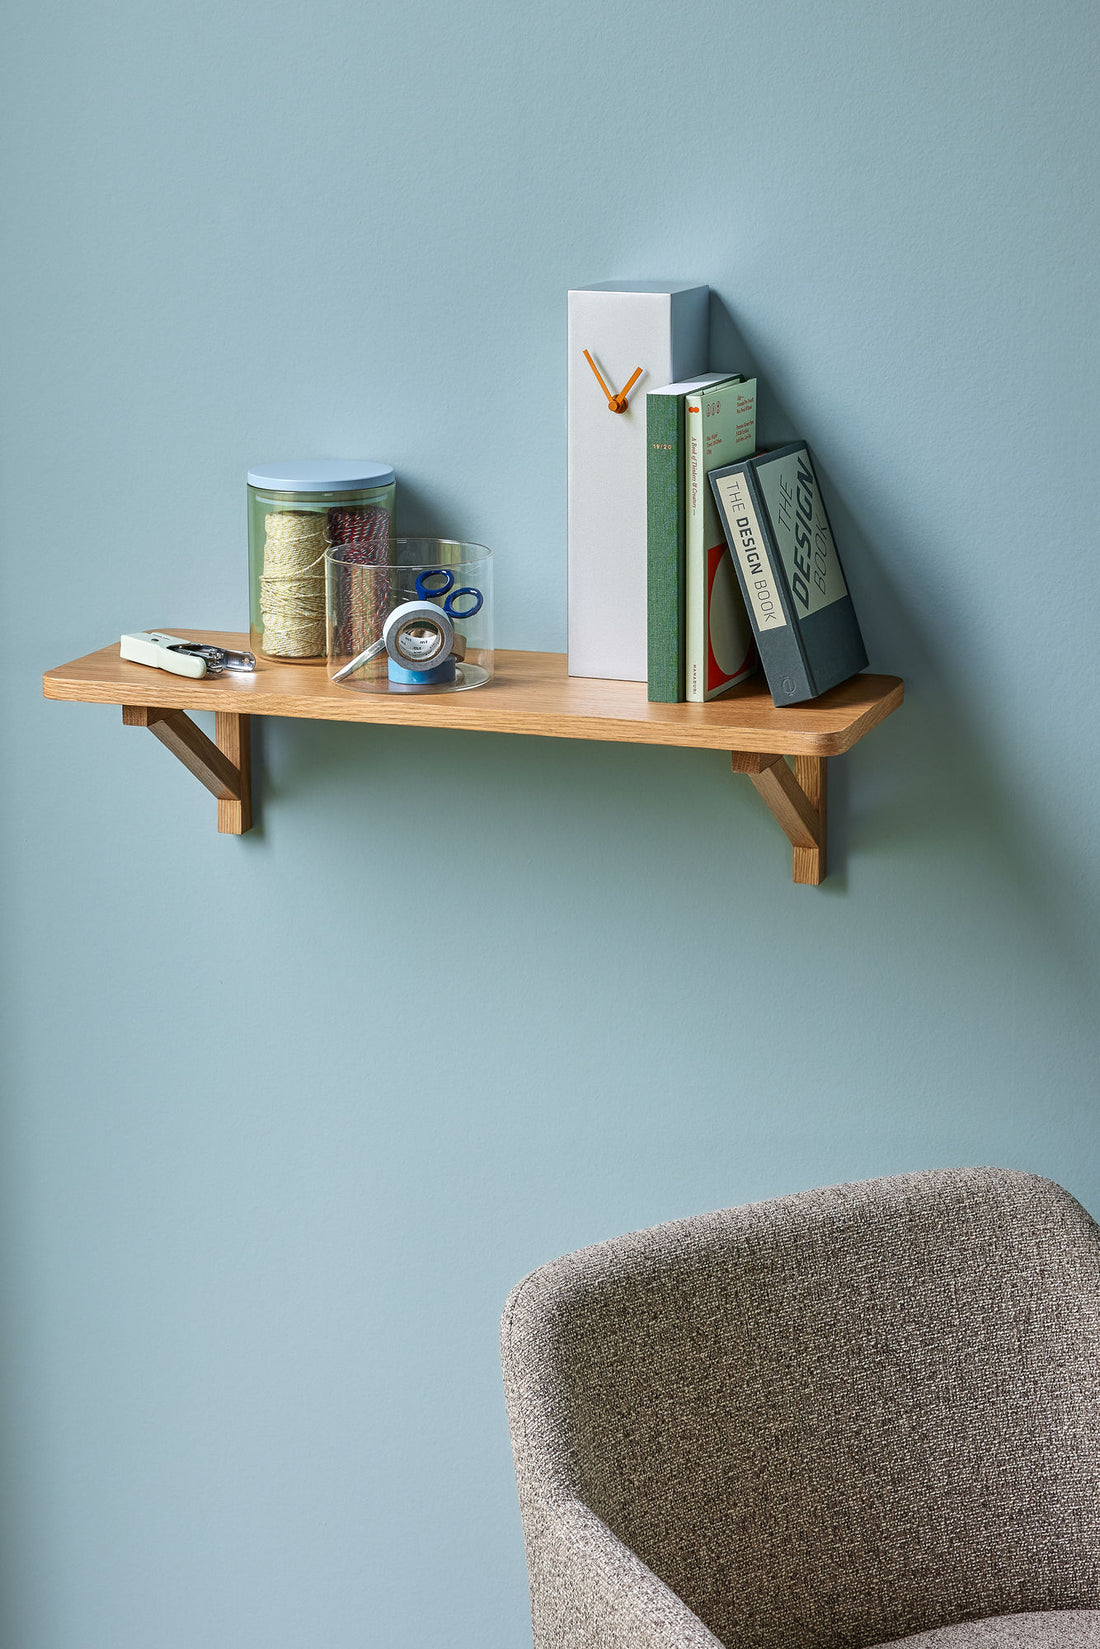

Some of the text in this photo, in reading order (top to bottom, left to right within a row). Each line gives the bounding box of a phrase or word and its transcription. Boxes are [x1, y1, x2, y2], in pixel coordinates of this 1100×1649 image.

[726, 481, 776, 622] THE DESIGN BOOK
[777, 474, 793, 531] THE
[793, 456, 813, 611] DESIGN
[813, 516, 829, 595] BOOK
